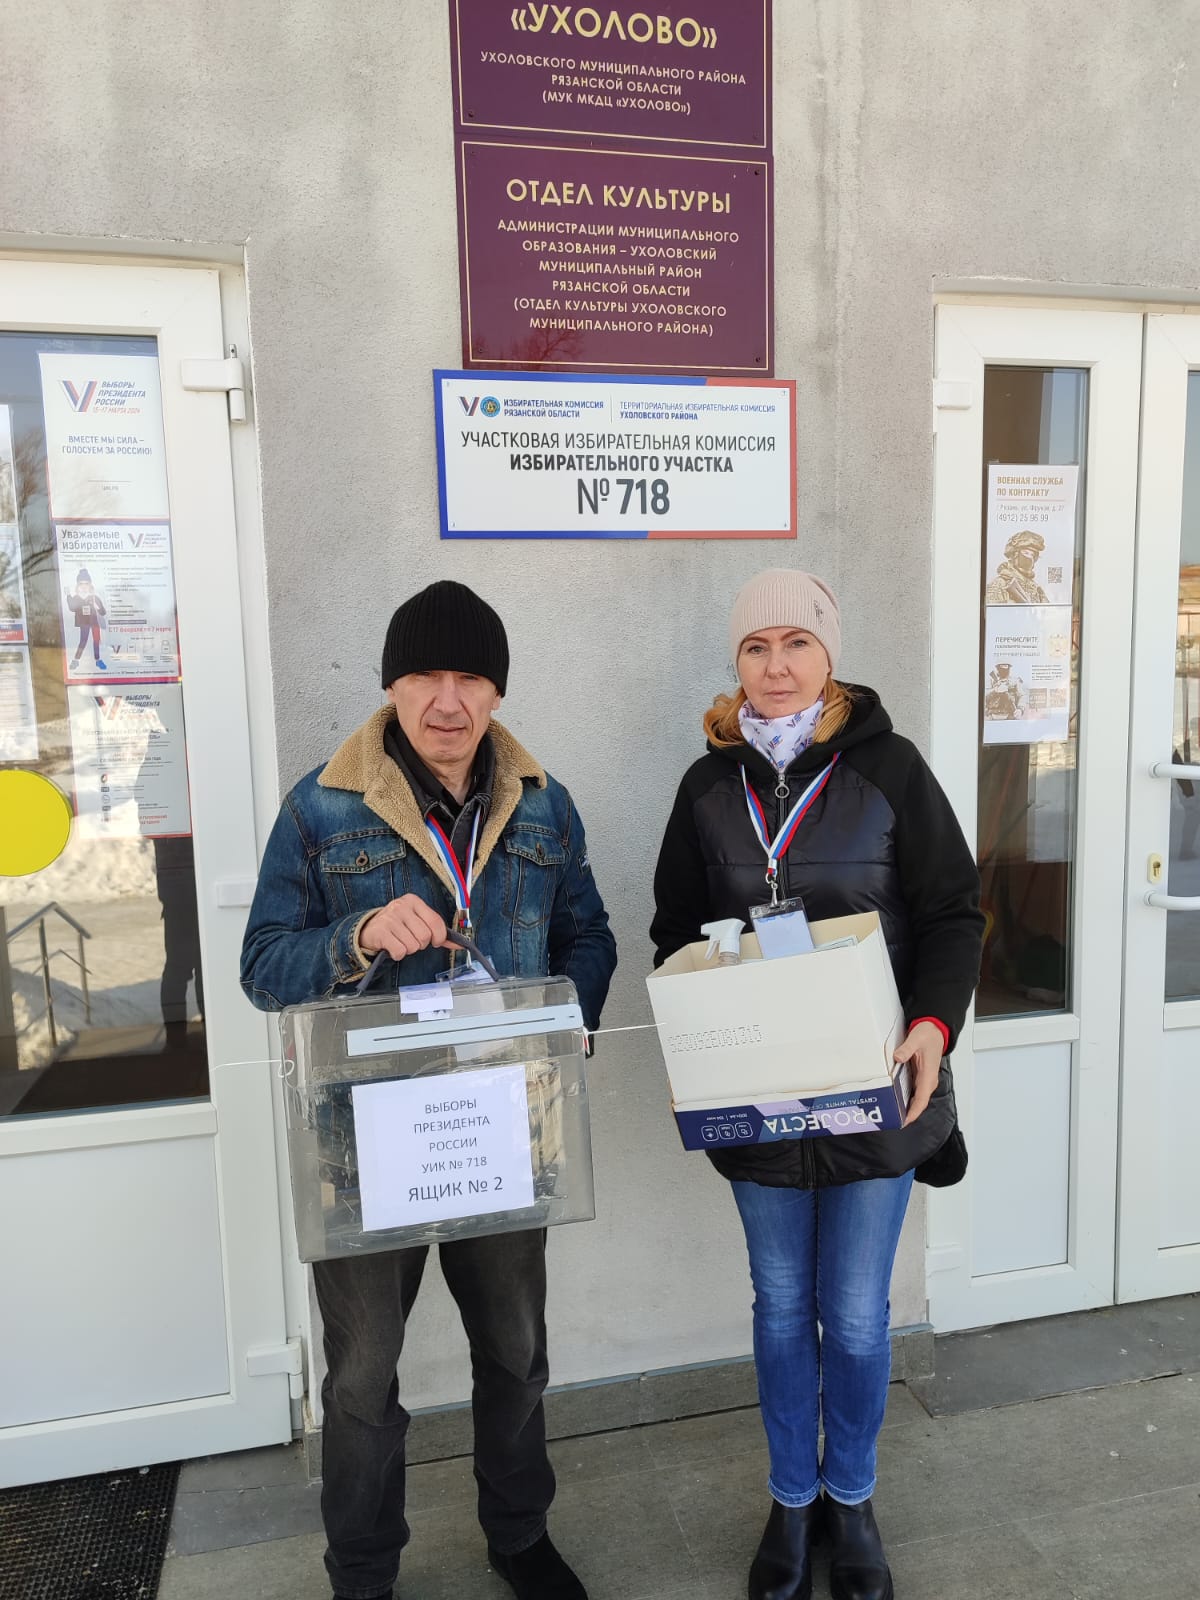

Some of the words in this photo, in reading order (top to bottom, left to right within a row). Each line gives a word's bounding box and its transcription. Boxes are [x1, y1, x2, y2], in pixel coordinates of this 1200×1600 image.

[510, 2, 718, 48] «УХОЛОВО»
[480, 51, 576, 70] УХОЛОВСКОГО
[580, 60, 695, 81] МУНИЦИПАЛЬНОГО
[698, 69, 746, 85] РАЙОНА
[551, 74, 623, 91] РЯЗАНСКОЙ
[626, 81, 682, 96] ОБЛАСТИ
[542, 92, 573, 105] (МУК
[577, 95, 613, 108] МКДЦ
[616, 98, 691, 115] «УХОЛОВО»)
[506, 178, 594, 206] ОТДЕЛ
[603, 184, 731, 214] КУЛЬТУРЫ
[497, 219, 614, 236] АДМИНИСТРАЦИИ
[618, 226, 739, 243] МУНИЦИПАЛЬНОГО
[522, 239, 616, 255] ОБРАЗОВАНИЯ
[630, 245, 717, 261] УХОЛОВСКИЙ
[539, 260, 655, 276] МУНИЦИПАЛЬНЫЙ
[659, 264, 702, 279] РАЙОН
[552, 280, 628, 294] РЯЗАНСКОЙ
[632, 284, 690, 297] ОБЛАСТИ
[514, 298, 561, 311] (ОТДЕЛ
[565, 300, 628, 313] КУЛЬТУРЫ
[631, 303, 727, 317] УХОЛОВСКОГО
[529, 317, 653, 333] МУНИЦИПАЛЬНОГО
[657, 321, 714, 336] РАЙОНА)
[101, 381, 136, 389] ВЫБОРЫ
[95, 398, 126, 406] РОССИИ
[97, 390, 146, 398] ПРЕЗИДЕНТА
[504, 398, 563, 408] ИЗБИРАТЕЛЬНАЯ
[565, 400, 604, 409] КОМИССИЯ
[620, 401, 683, 411] ТЕРРИТОРИАЛЬНАЯ
[685, 403, 739, 412] ИЗБИРАТЕЛЬНАЯ
[740, 404, 776, 413] КОМИССИЯ
[504, 407, 546, 418] РЯЗАНСКОЙ
[548, 409, 581, 418] ОБЛАСТИ
[620, 411, 670, 420] УХОЛОВСКОГО
[671, 411, 698, 420] РАЙОНА
[68, 435, 99, 444] ВМЕСТЕ
[101, 436, 115, 444] МЫ
[117, 436, 138, 444] СИЛА
[461, 431, 559, 448] УЧАСТКОВАЯ
[565, 433, 690, 451] ИЗБИРАТЕЛЬНАЯ
[695, 435, 776, 452] КОМИССИЯ
[62, 445, 103, 454] ГОЛОСУЕМ
[105, 446, 115, 454] ЗА
[510, 454, 660, 472] ИЗБИРАТЕЛЬНОГО
[663, 456, 734, 473] УЧАСТКА
[997, 476, 1030, 485] ВОЕННАЯ
[1032, 477, 1064, 486] СЛУЖБА
[577, 477, 610, 515] №
[616, 478, 670, 515] 718
[997, 488, 1007, 497] ПО
[1008, 488, 1050, 497] КОНТРАКТУ
[61, 529, 120, 539] Уважаемые
[62, 539, 123, 551] избиратели!
[424, 1098, 477, 1114] ВЫБОРЫ
[825, 1100, 847, 1109] WHITE
[848, 1096, 878, 1106] CRYSTAL
[414, 1115, 490, 1134] ПРЕЗИДЕНТА
[763, 1105, 883, 1135] PROJECTA
[429, 1137, 478, 1152] РОССИИ
[421, 1161, 446, 1174] УИК
[449, 1159, 463, 1170] №
[467, 1156, 487, 1168] 718
[408, 1181, 463, 1202] ЯЩИК
[468, 1179, 488, 1193] №
[494, 1176, 503, 1191] 2
